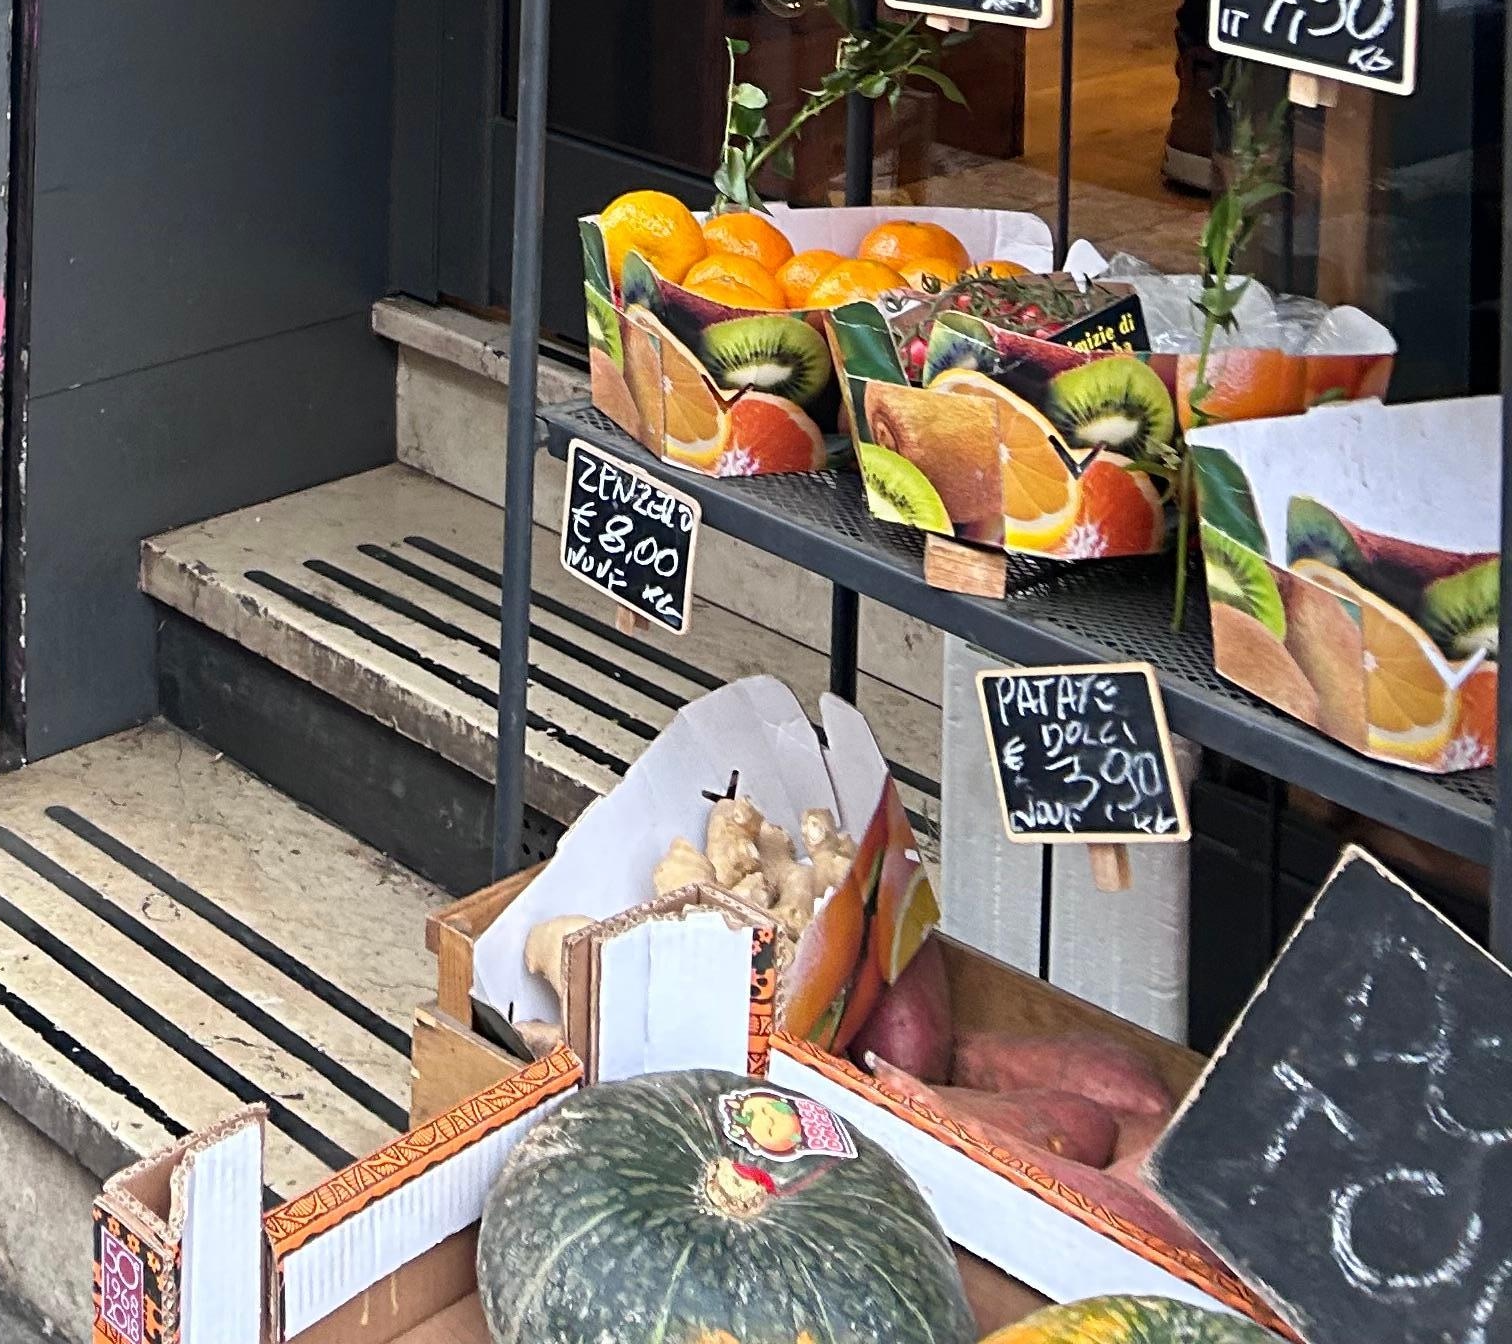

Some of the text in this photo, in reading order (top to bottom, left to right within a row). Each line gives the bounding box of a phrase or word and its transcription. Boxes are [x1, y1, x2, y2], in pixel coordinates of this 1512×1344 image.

[1220, 9, 1249, 38] IT
[1118, 312, 1136, 335] di
[571, 501, 679, 577] € 8,00
[996, 674, 1119, 727] PATATE
[1002, 736, 1027, 771] €
[1040, 720, 1138, 758] DOLCI
[105, 1272, 139, 1319] 1968
[105, 1295, 140, 1342] 2018
